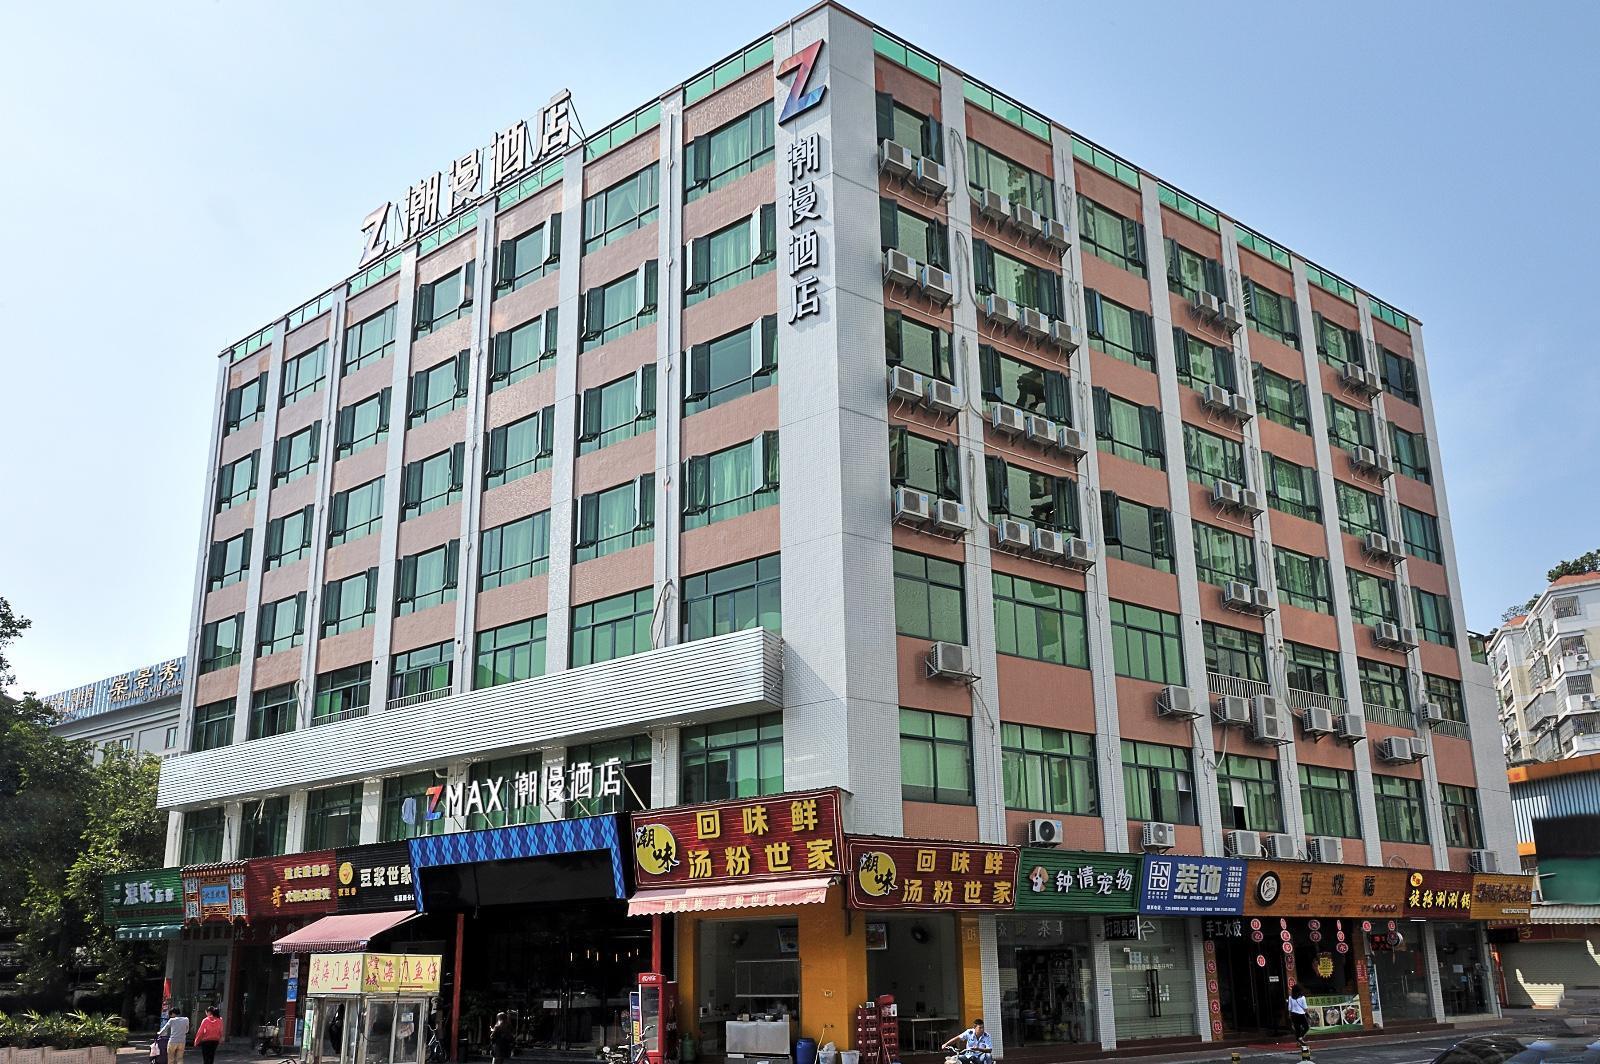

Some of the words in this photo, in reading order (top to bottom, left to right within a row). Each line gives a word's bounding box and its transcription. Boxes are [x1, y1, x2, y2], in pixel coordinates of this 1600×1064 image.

[776, 38, 828, 125] Z
[403, 88, 571, 243] 潮漫酒店
[787, 132, 821, 324] 潮漫酒店
[515, 757, 622, 809] 潮漫酒店
[696, 799, 818, 839] 回味鲜
[636, 826, 679, 872] 潮味
[688, 838, 835, 879] 汤粉世家
[917, 850, 1004, 874] 回味鲜
[360, 865, 413, 887] 豆浆世家
[861, 854, 896, 894] 潮味
[902, 878, 1012, 904] 汤粉世家
[1056, 866, 1132, 895] 钟情宠物
[1175, 864, 1222, 894] 装饰
[1206, 920, 1242, 937] 手工水饺
